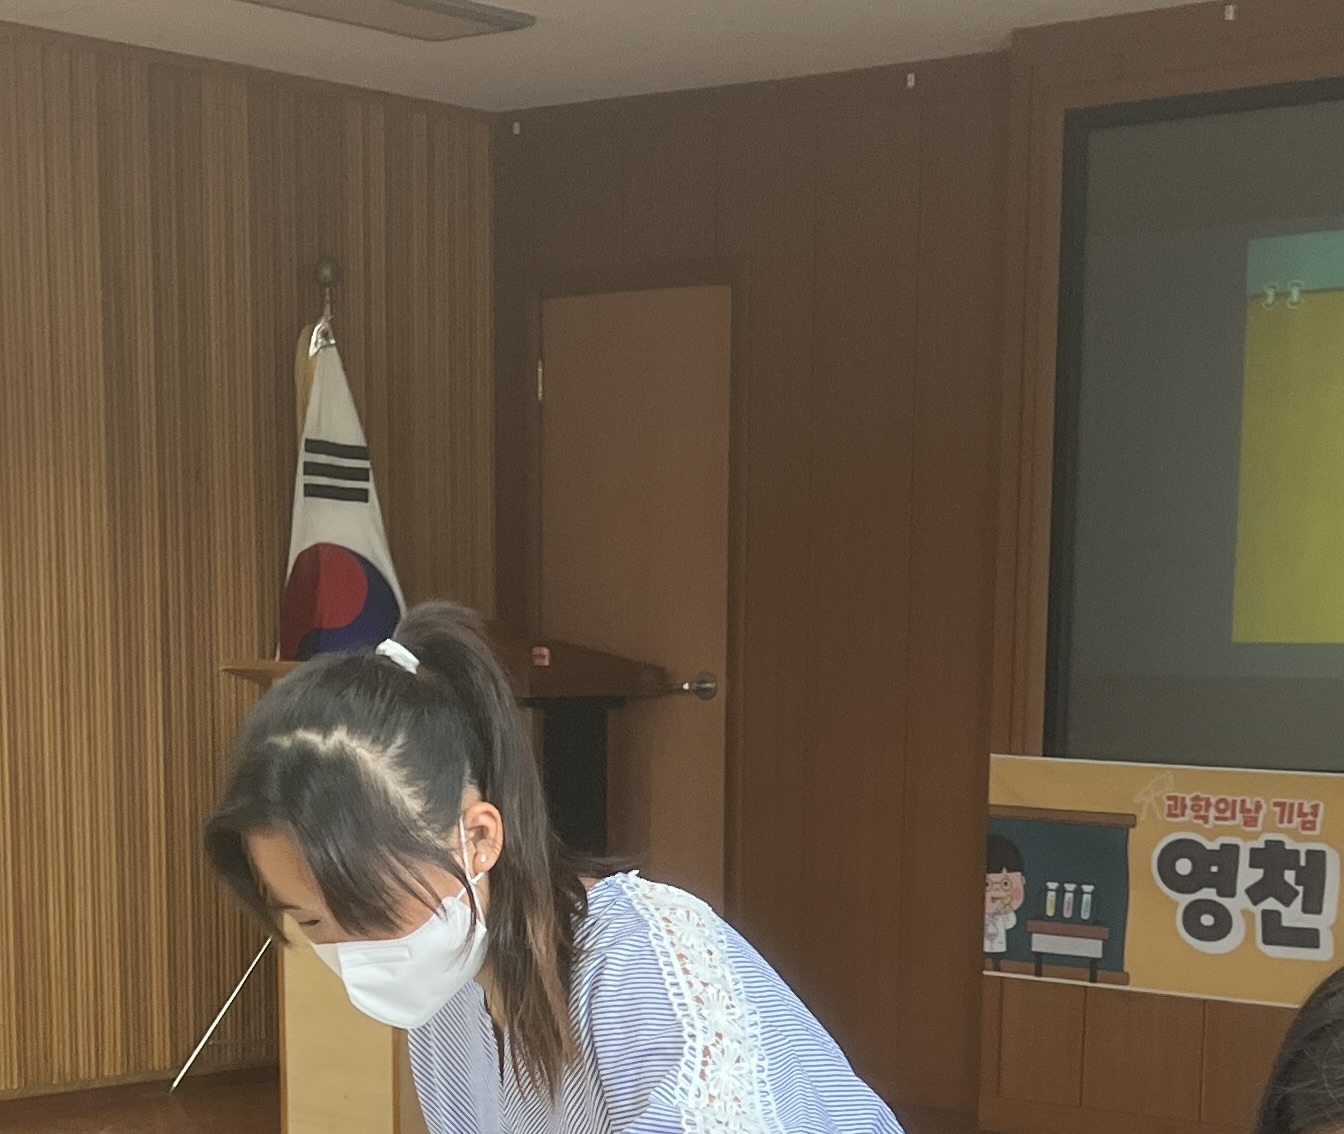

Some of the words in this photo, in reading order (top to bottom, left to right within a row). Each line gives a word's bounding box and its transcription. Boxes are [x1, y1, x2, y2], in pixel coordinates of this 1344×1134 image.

[1165, 794, 1263, 828] 과학의날
[1272, 800, 1321, 832] 기념
[1156, 837, 1328, 950] 영천
